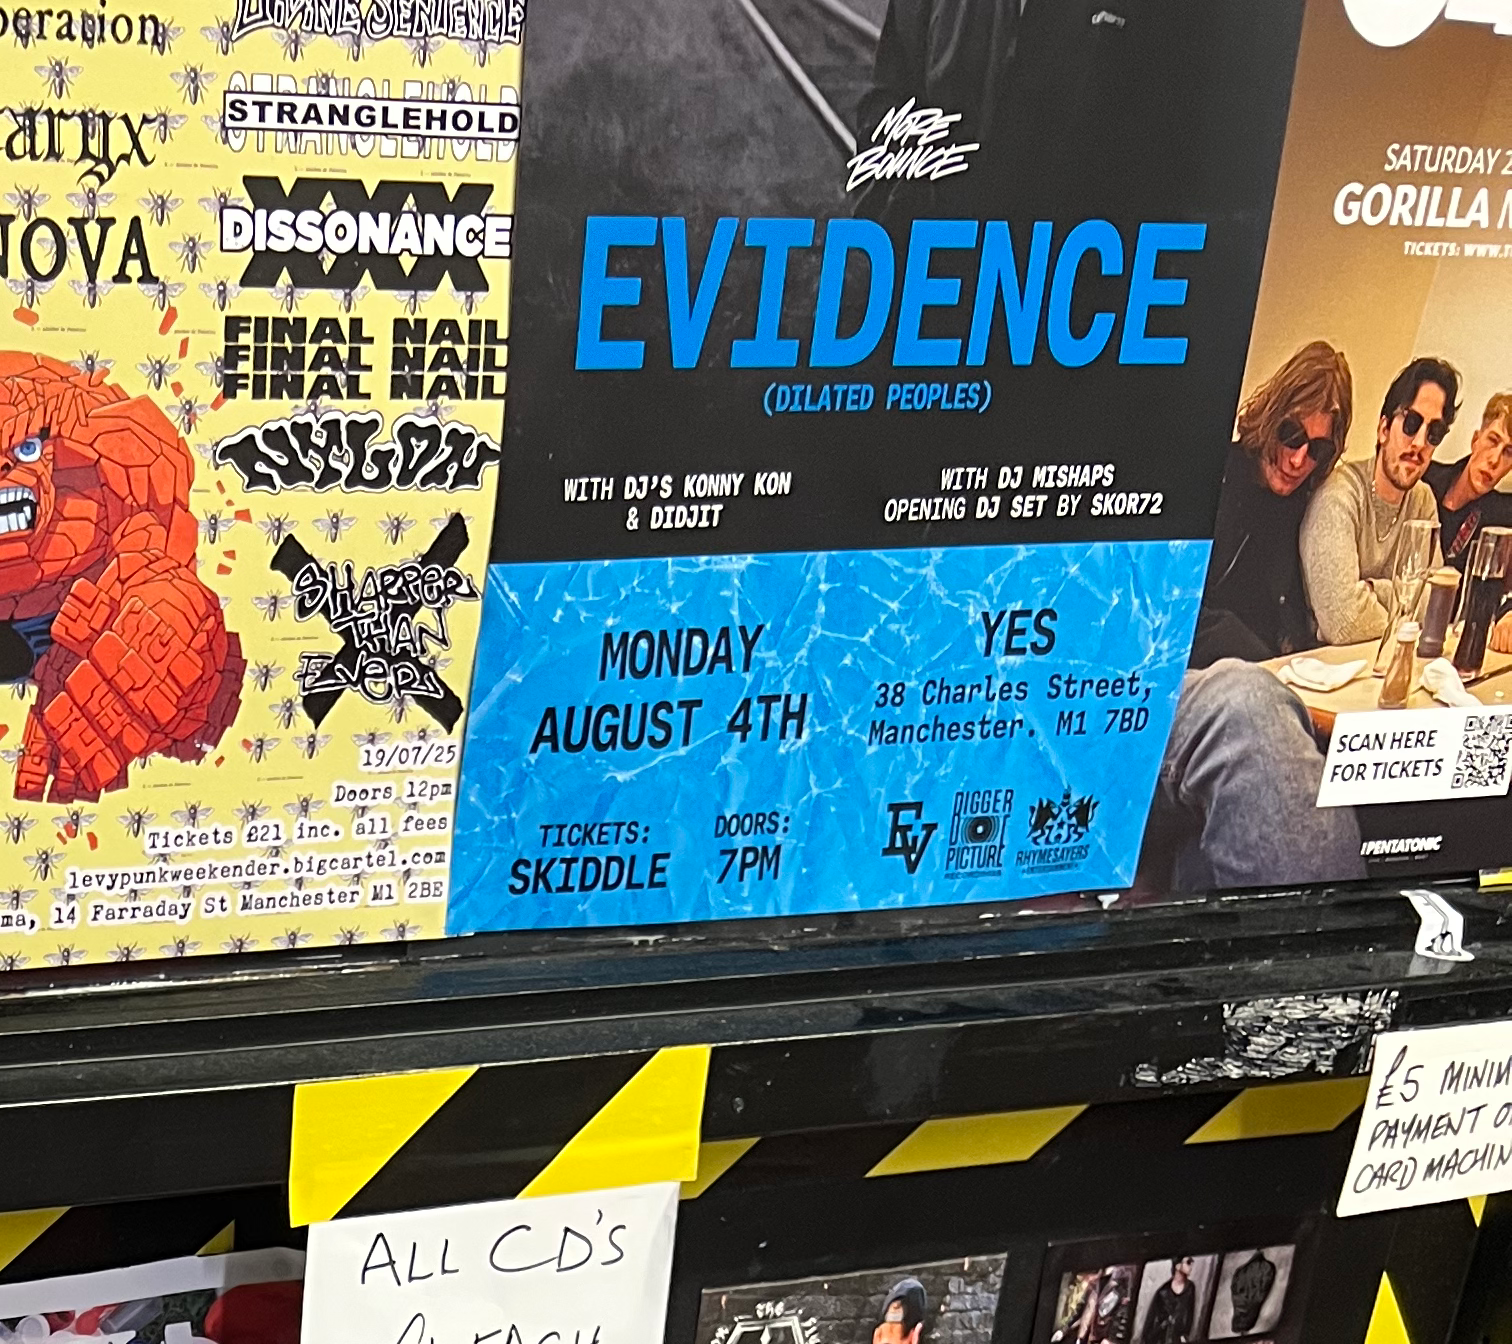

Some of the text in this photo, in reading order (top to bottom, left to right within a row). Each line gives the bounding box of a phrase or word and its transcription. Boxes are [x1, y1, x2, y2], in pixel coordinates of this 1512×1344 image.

[228, 99, 519, 134] STRANGLEHOLD
[871, 97, 964, 147] MORE
[845, 142, 981, 193] BOUNCE
[1384, 143, 1499, 175] SATURDAY
[1333, 182, 1489, 229] GORILLA
[220, 205, 514, 259] DISSONANCE
[573, 216, 1208, 371] EVIDENCE
[224, 316, 509, 346] FINAL NAIL
[224, 345, 509, 373] FINAL NAIL
[223, 373, 507, 401] FINAL NAIL
[762, 381, 992, 417] (DILATED PEOPLES)
[564, 472, 792, 504] WITH DJ'S KONNY KON
[940, 464, 1116, 492] WITH DJ MISHAPS
[626, 504, 725, 531] & DIDJIT
[884, 492, 1164, 525] OPENING DJ SET BY SKOR72
[981, 608, 1059, 658] YES
[599, 625, 764, 682] MONDAY
[875, 669, 1153, 710] 38 Charles Street,
[530, 693, 808, 755] AUGUST 4TH
[1056, 709, 1088, 736] M1
[1105, 707, 1149, 734] 7BD
[362, 744, 457, 768] 19/07/25
[1336, 730, 1438, 753] SCAN HERE
[1330, 759, 1444, 783] FOR TICKETS
[334, 779, 454, 803] Doors 12pm
[148, 814, 448, 850] Tickets £21 inc. all fees
[539, 812, 790, 848] TICKETS: DOORS:
[69, 850, 446, 891] levypunkweekender.bigcartel.com
[508, 844, 782, 895] SKIDDLE 7PM
[54, 906, 77, 925] 14
[91, 899, 192, 924] Farraday
[204, 896, 228, 914] St
[241, 887, 360, 912] Manchester
[372, 884, 395, 903] M1
[408, 881, 444, 900] 2BE
[1369, 1104, 1487, 1151] PAYMENT
[1353, 1158, 1417, 1193] CARD
[361, 1209, 626, 1286] ALL CD'S
